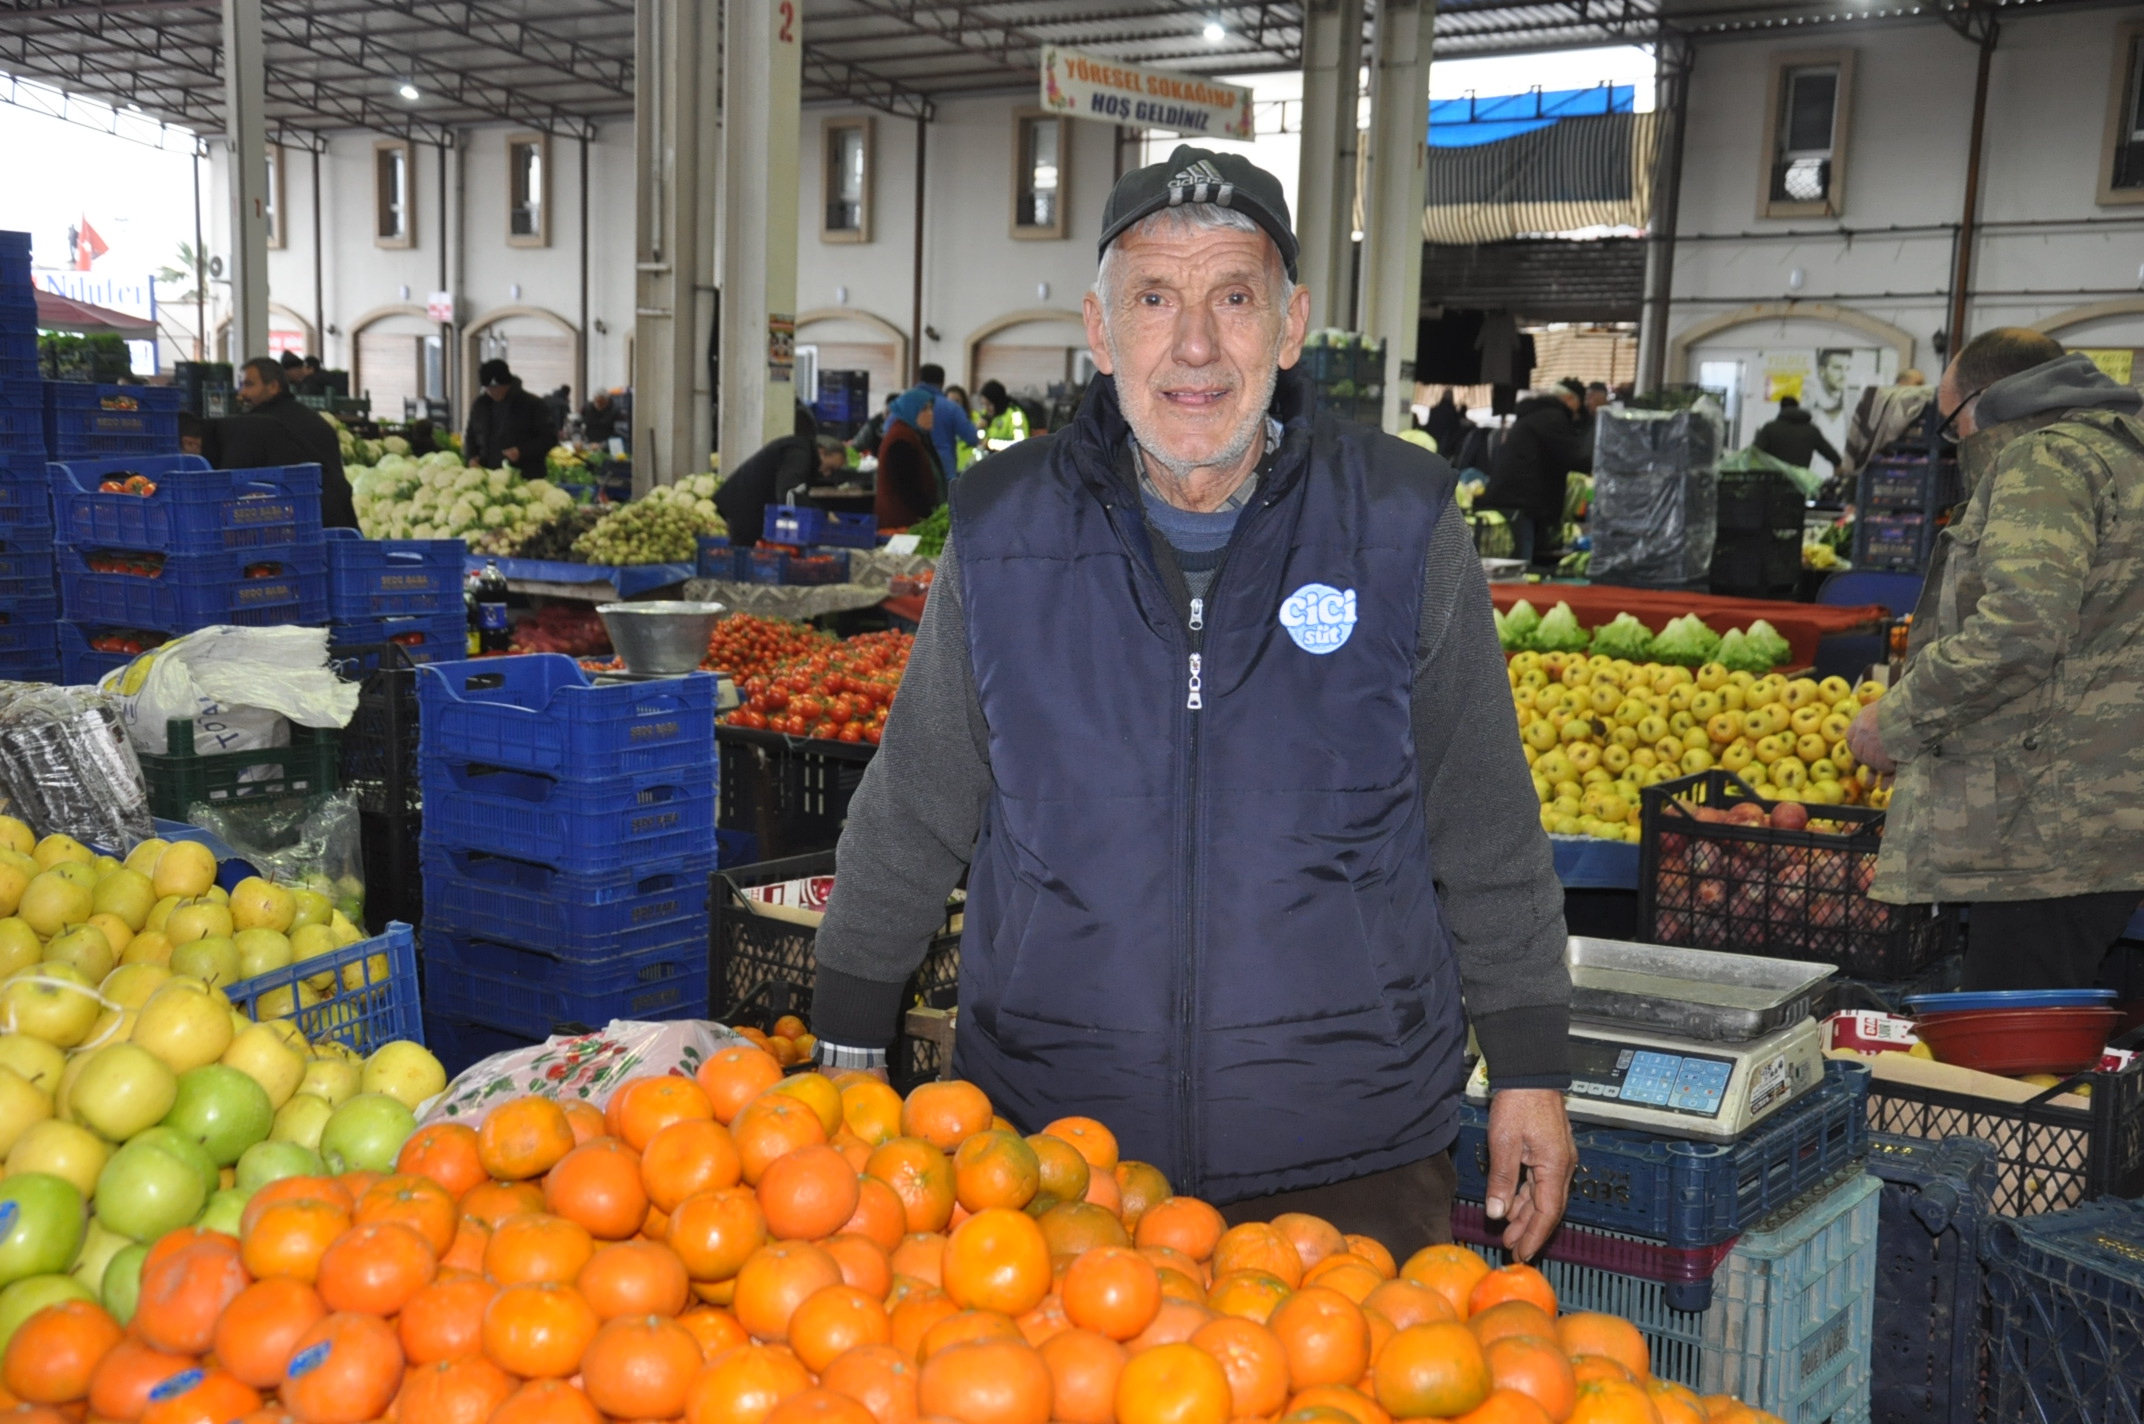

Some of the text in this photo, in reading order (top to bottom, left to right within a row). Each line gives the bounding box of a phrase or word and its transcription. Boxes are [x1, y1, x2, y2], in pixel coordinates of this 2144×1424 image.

[779, 0, 795, 43] 2
[1065, 58, 1144, 93] YÖRESEL
[1091, 92, 1210, 132] HOŞ GELDİNİZ
[1304, 625, 1342, 645] süt
